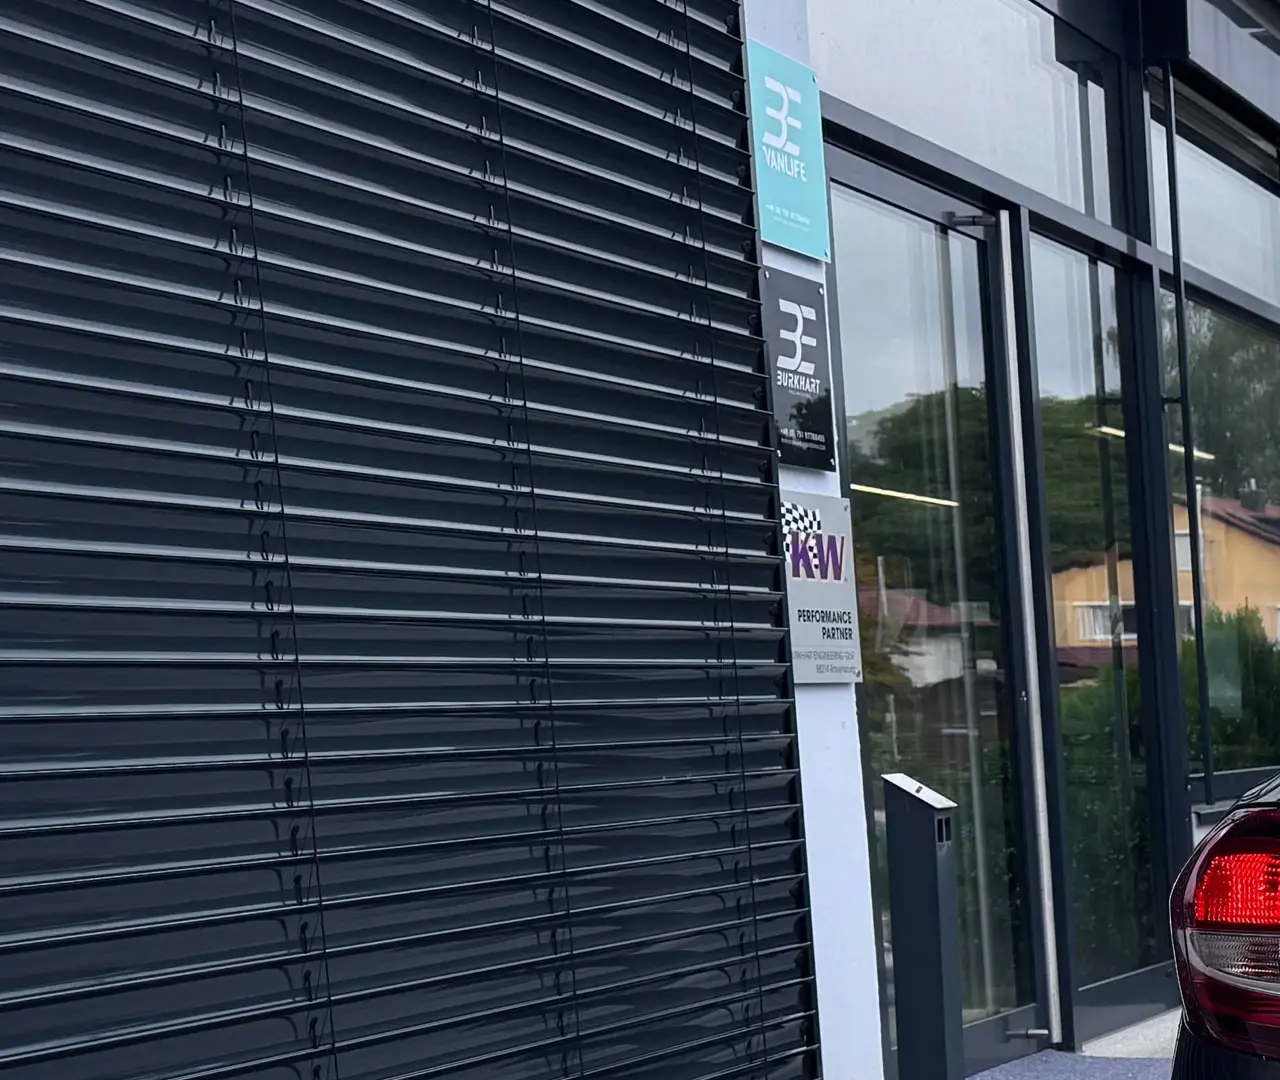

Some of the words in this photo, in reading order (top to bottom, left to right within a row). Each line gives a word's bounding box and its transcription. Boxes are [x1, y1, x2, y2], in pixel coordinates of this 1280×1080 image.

[762, 146, 806, 181] VANLIFE
[777, 370, 820, 393] BURKHART
[790, 531, 845, 581] KW
[797, 609, 852, 624] PERFORMANCE
[821, 626, 853, 640] PARTNER
